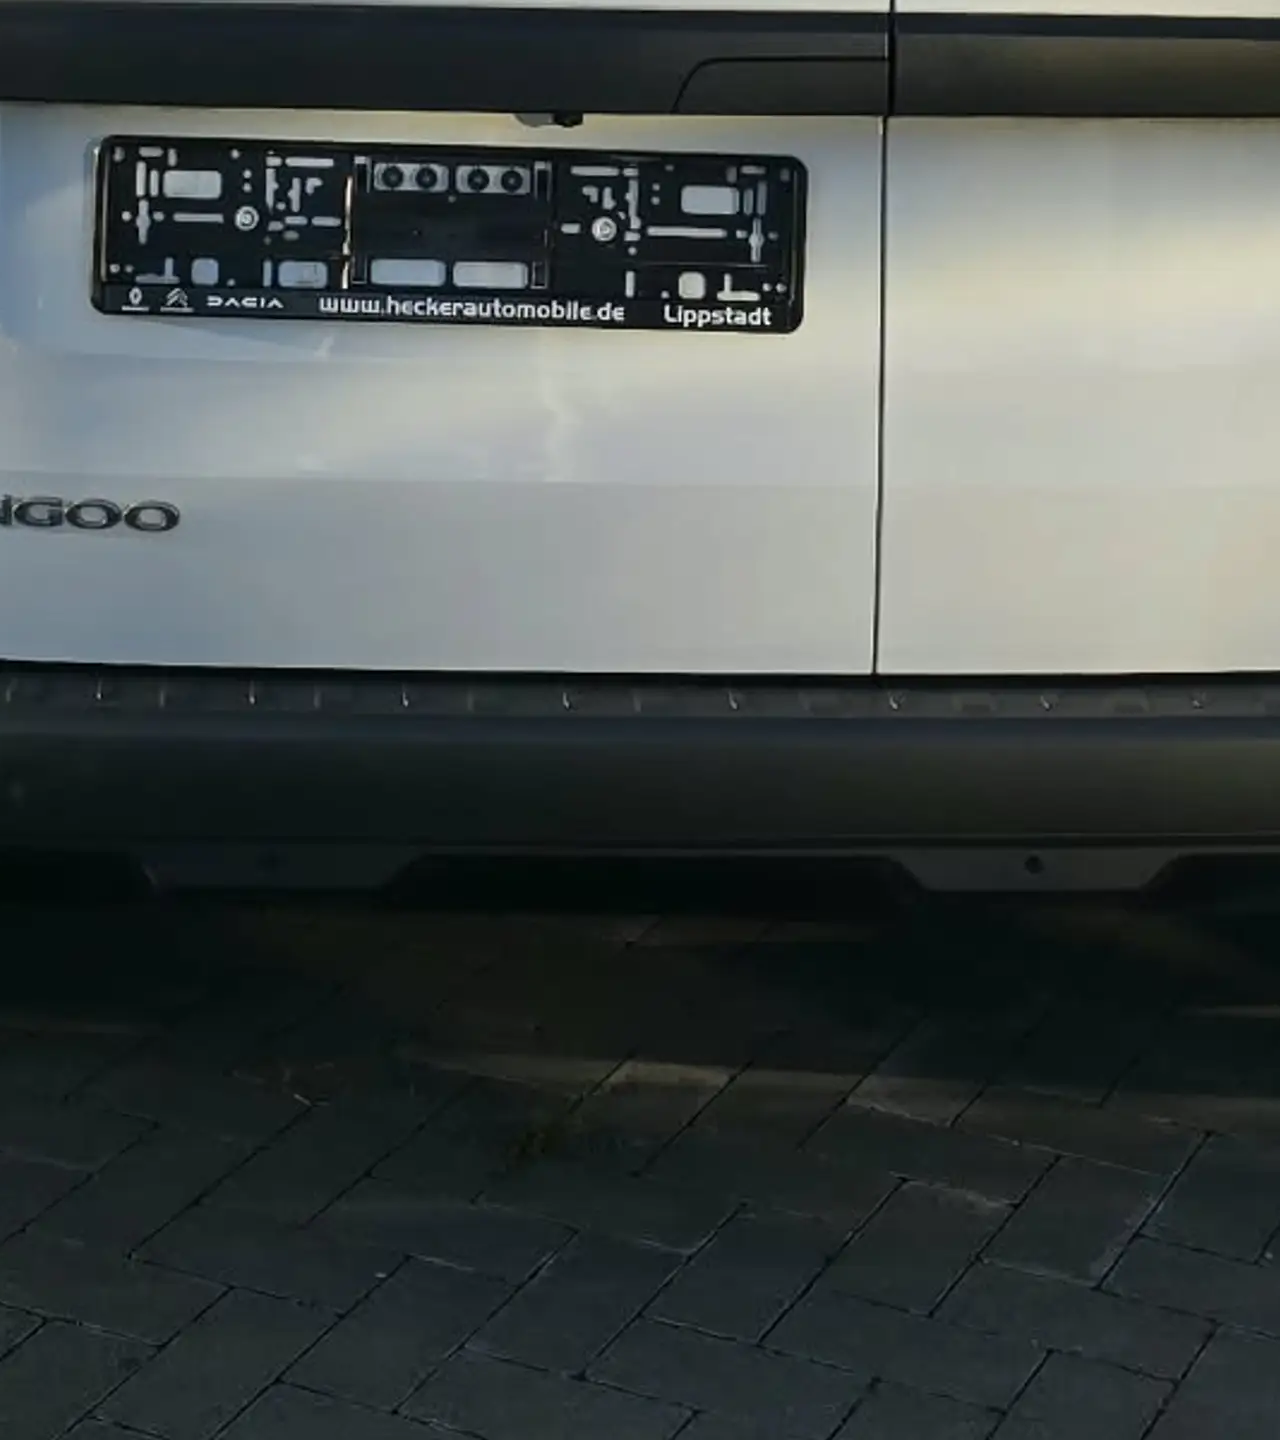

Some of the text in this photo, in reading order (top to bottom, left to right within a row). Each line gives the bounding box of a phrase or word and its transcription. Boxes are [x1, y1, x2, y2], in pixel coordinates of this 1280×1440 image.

[206, 295, 772, 328] DACIA www.heckerautomobile.de Lippstadt
